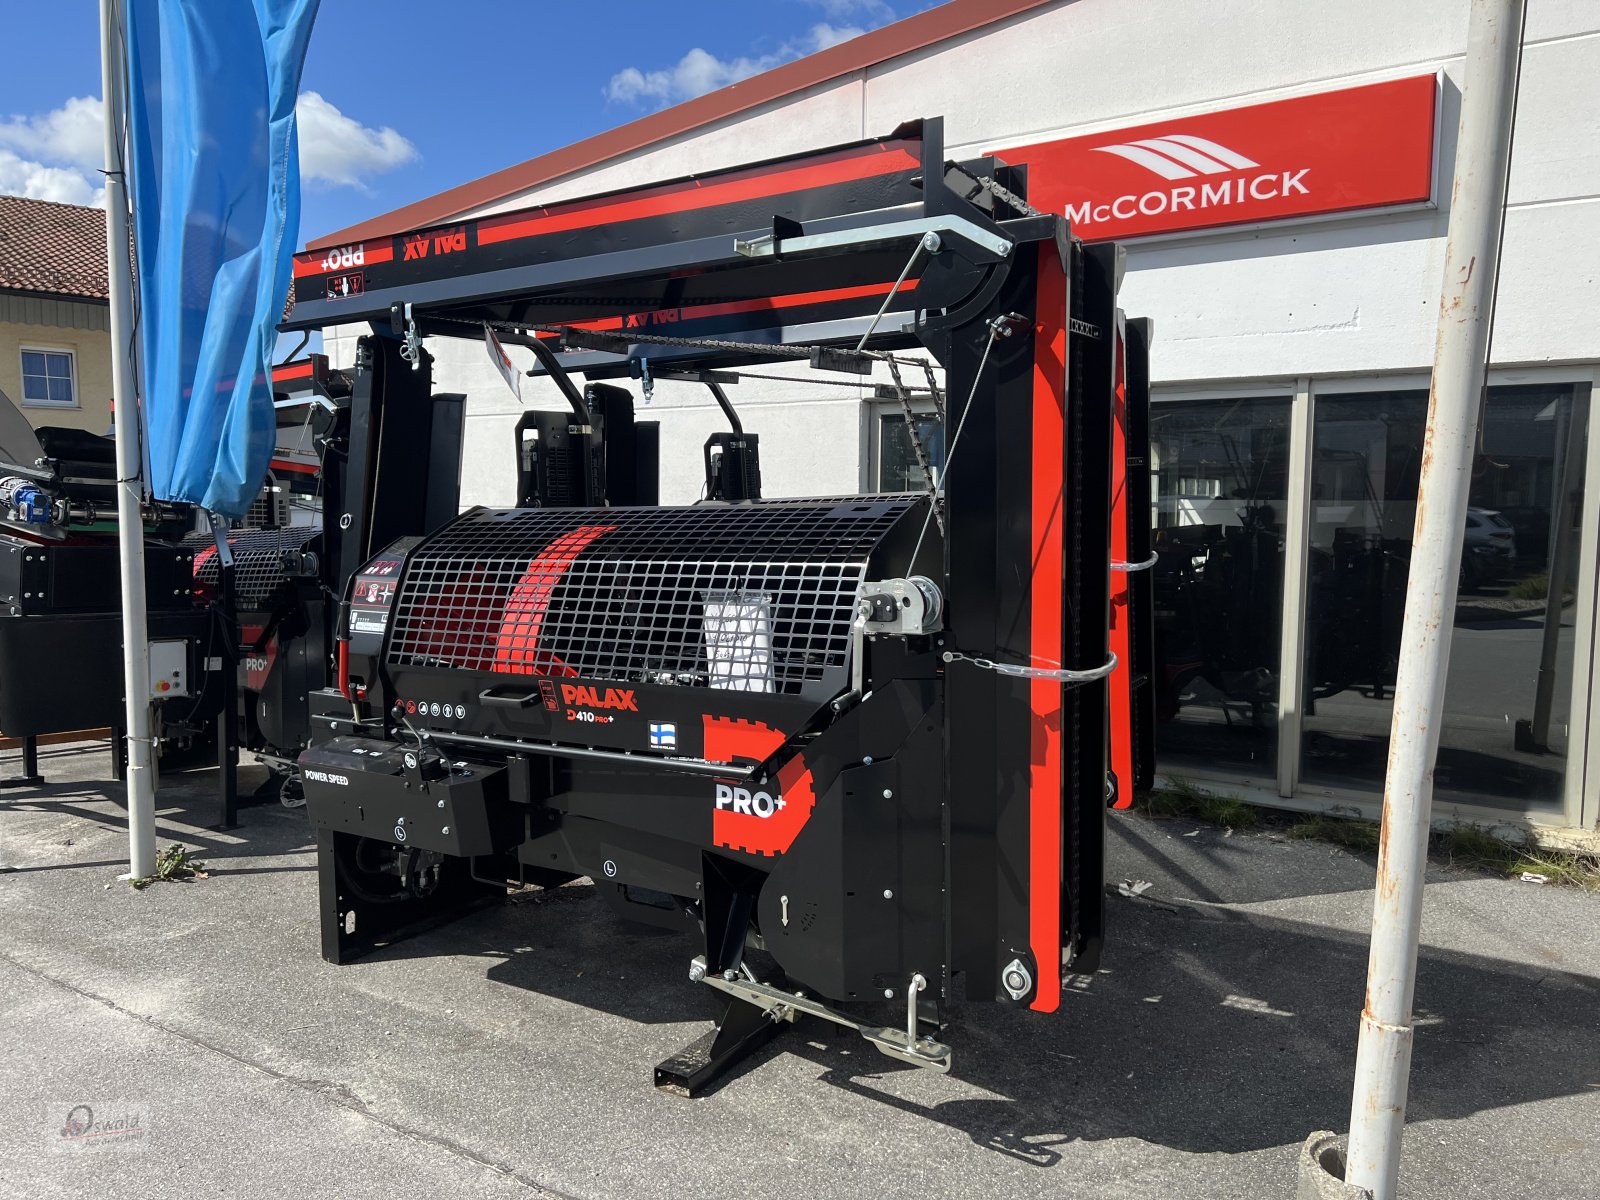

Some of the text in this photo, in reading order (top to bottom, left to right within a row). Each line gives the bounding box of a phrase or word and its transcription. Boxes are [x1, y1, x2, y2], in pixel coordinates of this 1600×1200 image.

[1065, 168, 1311, 224] McCORMICK
[321, 243, 365, 271] PRO+
[246, 658, 268, 672] PRO+
[560, 684, 638, 711] PALAX
[304, 769, 349, 786] POWER SPEED
[715, 784, 786, 818] PRO+
